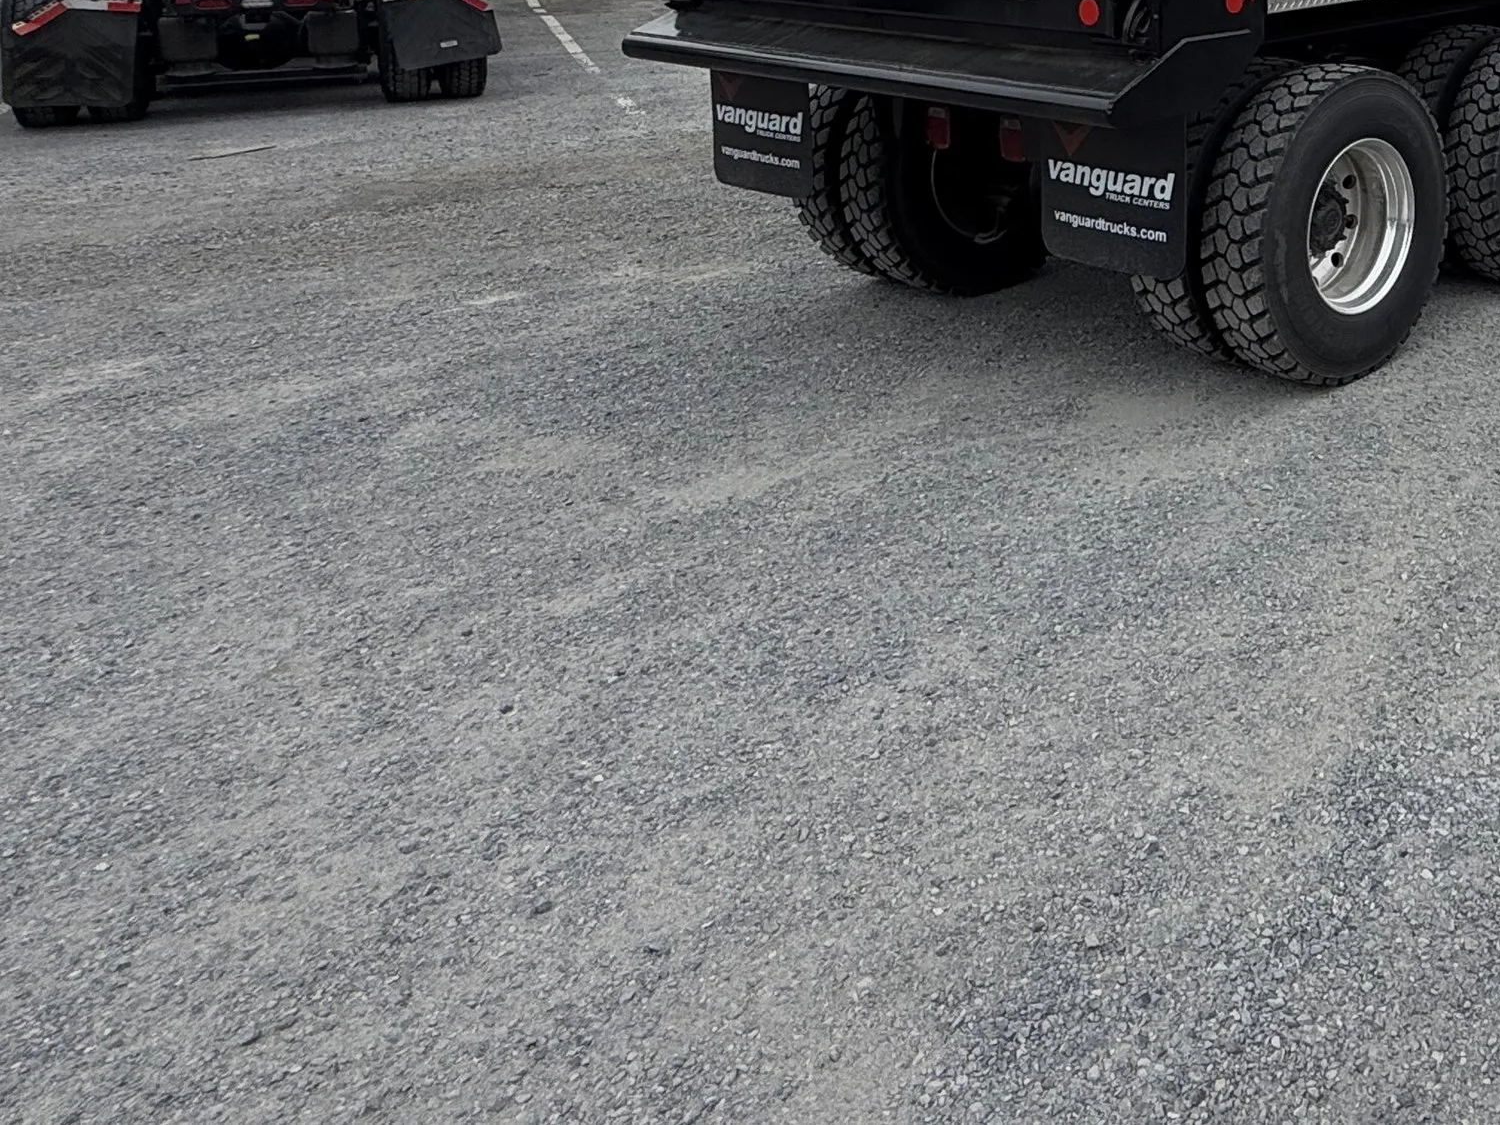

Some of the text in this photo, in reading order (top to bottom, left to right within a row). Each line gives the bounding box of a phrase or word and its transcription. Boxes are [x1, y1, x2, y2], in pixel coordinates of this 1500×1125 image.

[716, 103, 804, 135] vanguard
[721, 145, 801, 169] vanguardtrucks.com
[1047, 158, 1176, 201] vanguard
[1105, 191, 1171, 210] TRUCK CENTERS
[1053, 209, 1168, 243] vanguardtrucks.com
